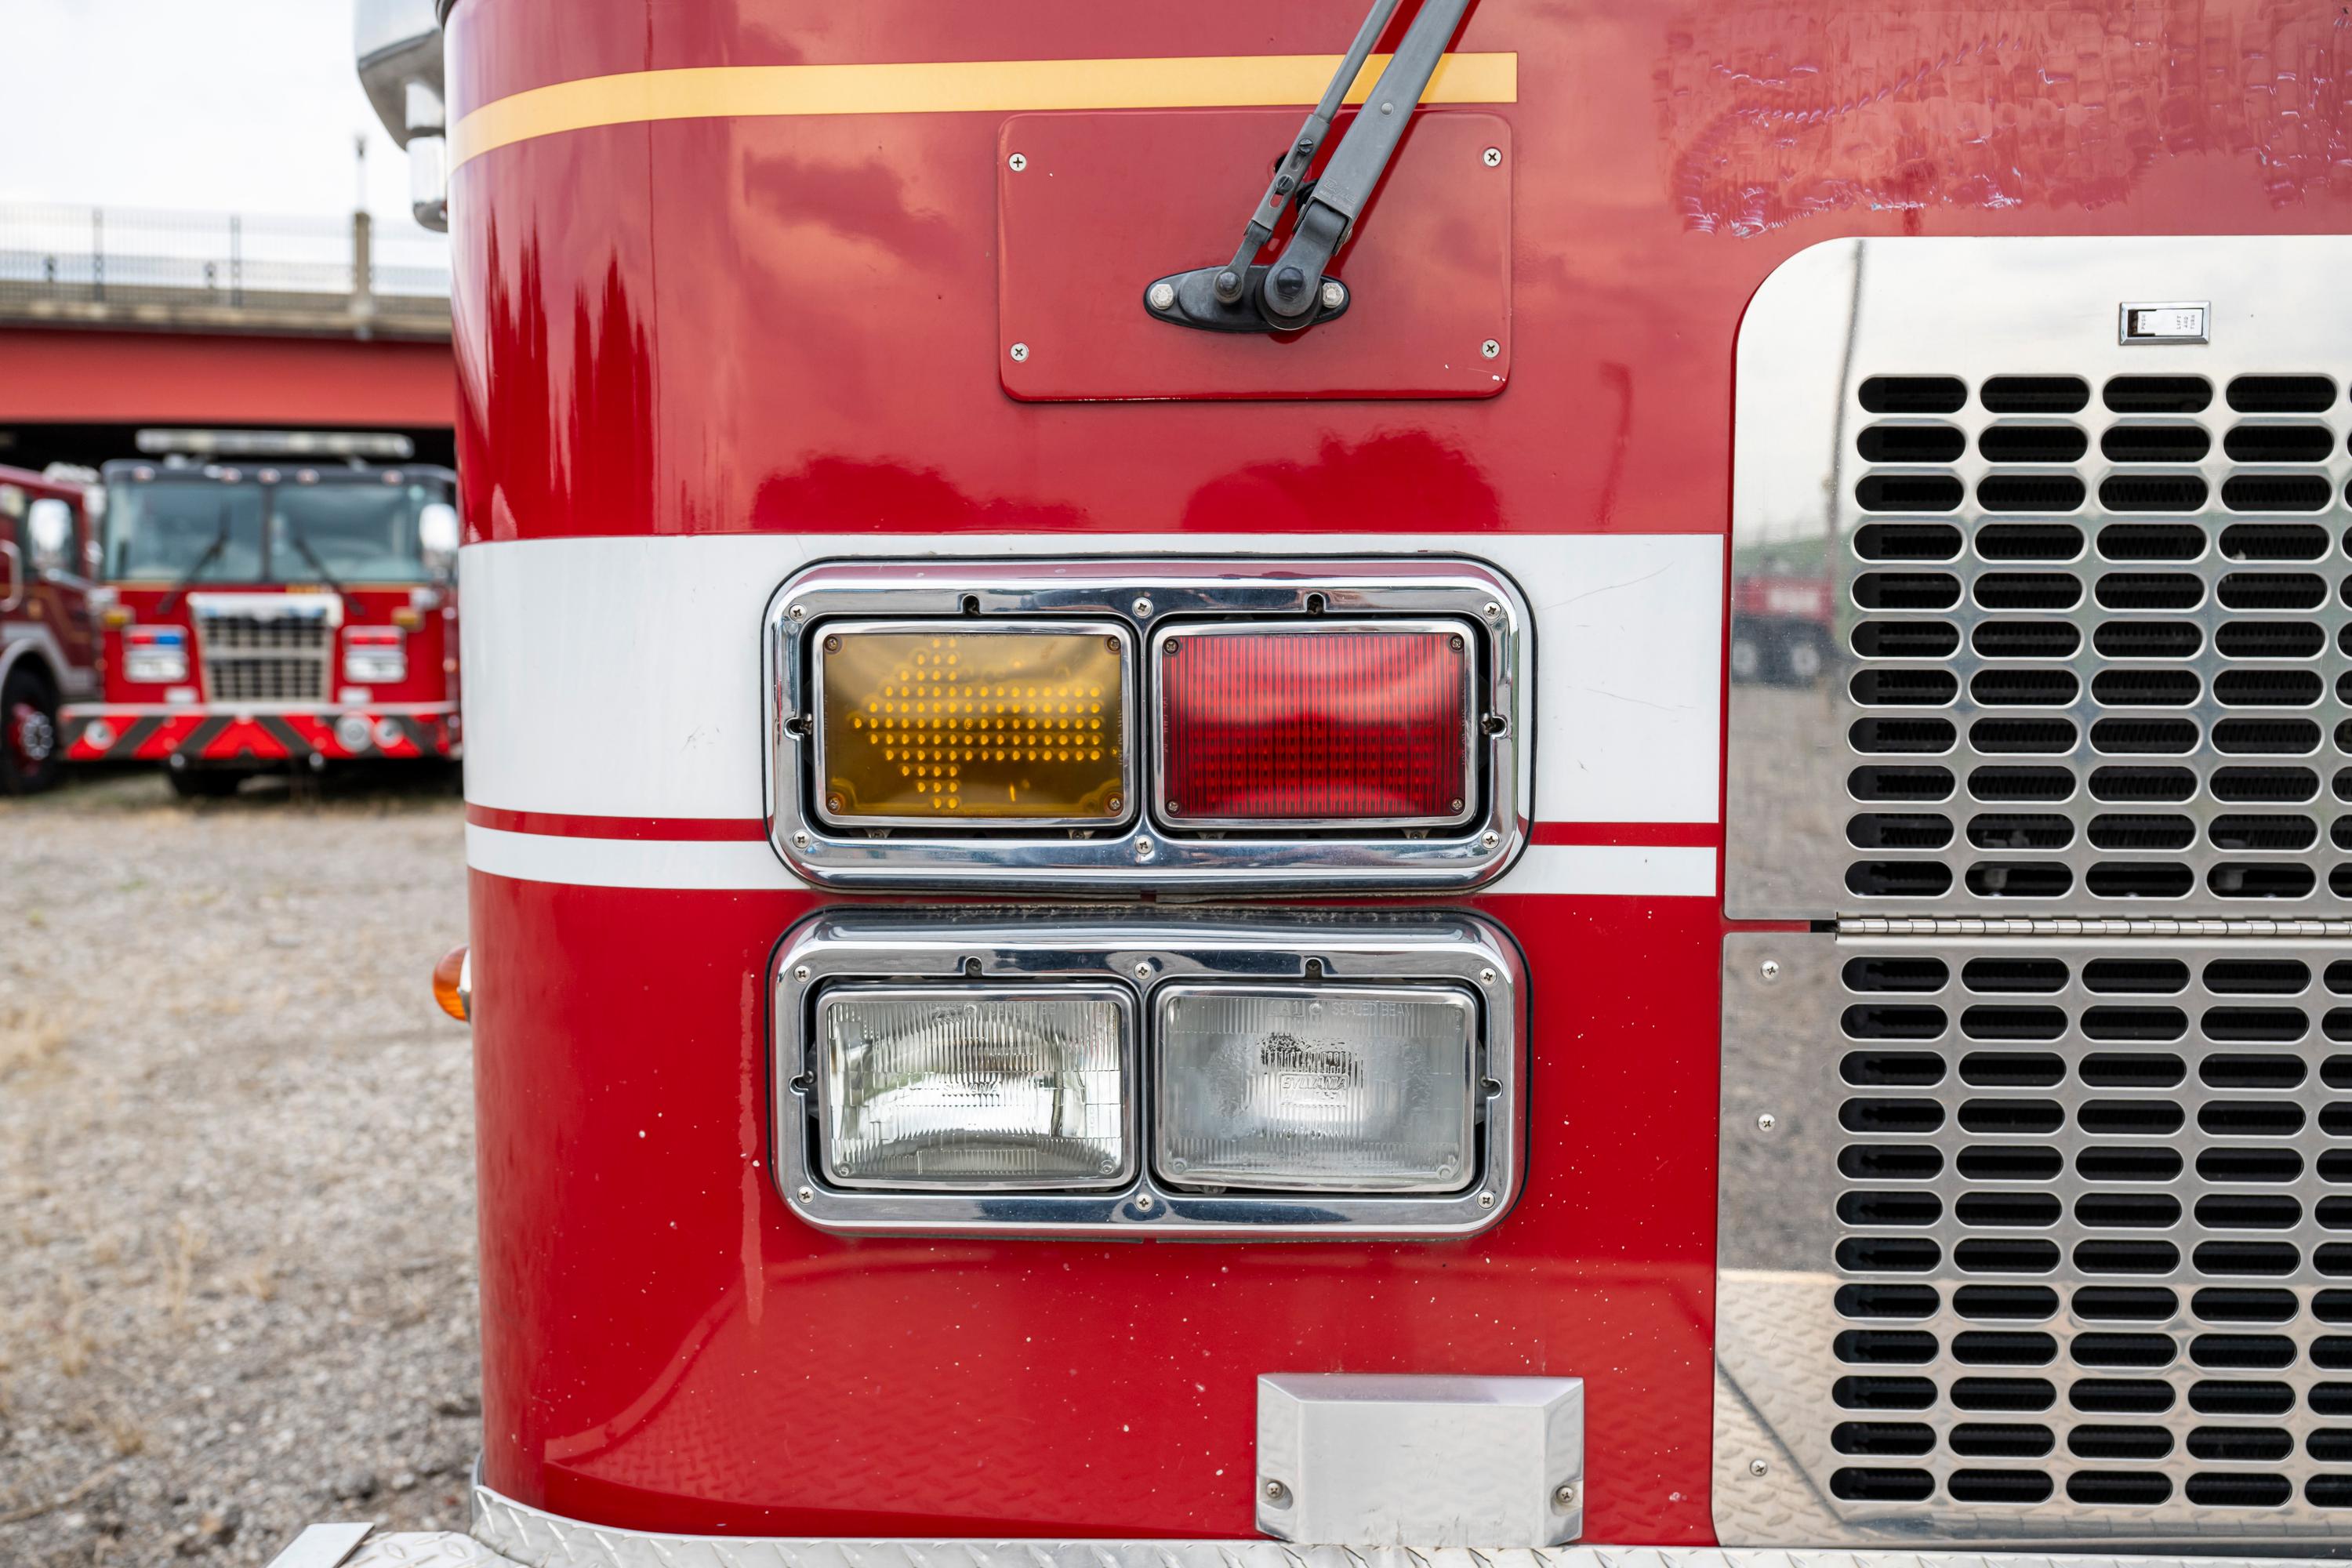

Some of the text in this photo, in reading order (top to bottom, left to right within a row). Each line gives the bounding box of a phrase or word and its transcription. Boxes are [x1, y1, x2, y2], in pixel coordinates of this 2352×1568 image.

[1332, 1002, 1413, 1017] SEALED BEAM
[1283, 1076, 1347, 1091] SYLVANIA
